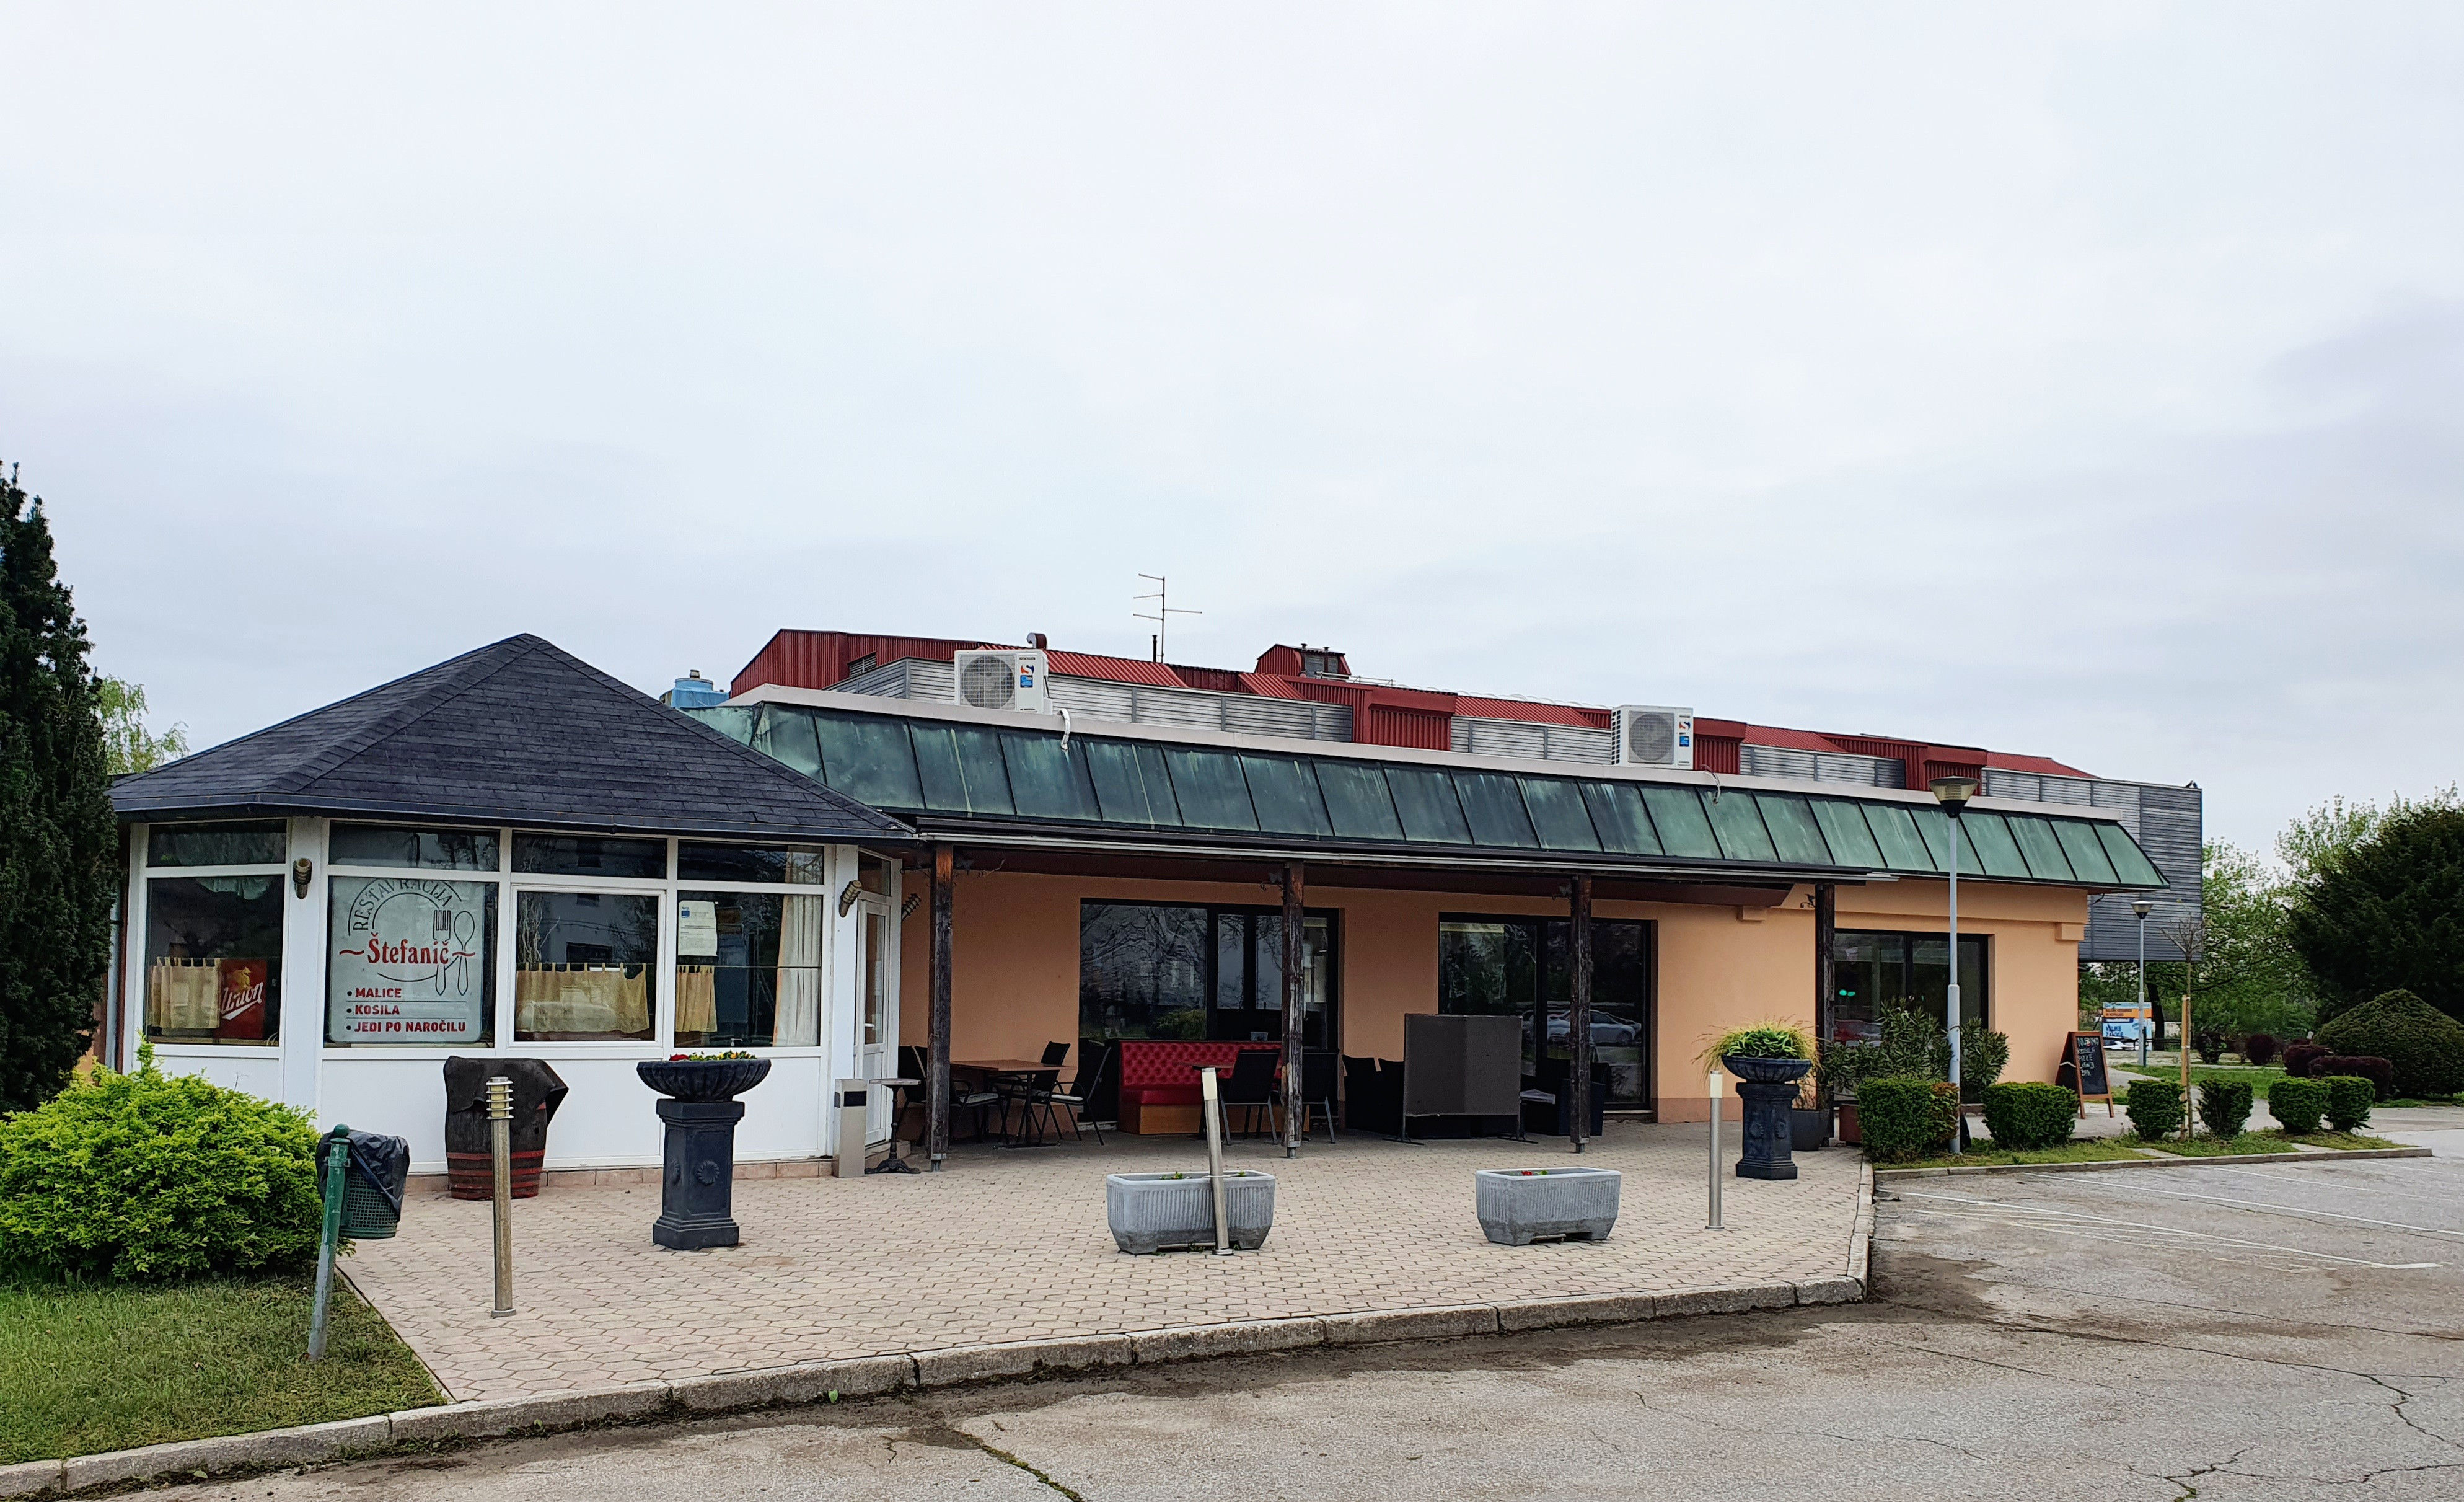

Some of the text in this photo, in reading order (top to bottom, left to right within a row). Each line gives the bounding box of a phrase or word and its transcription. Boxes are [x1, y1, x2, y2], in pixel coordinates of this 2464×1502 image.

[353, 879, 452, 930] RESTAVRACIJA
[367, 932, 449, 964] Štefanič
[355, 987, 402, 997] MALICE
[354, 1005, 400, 1015] KOSILA
[354, 1019, 465, 1032] JEDI PO NAROČILU
